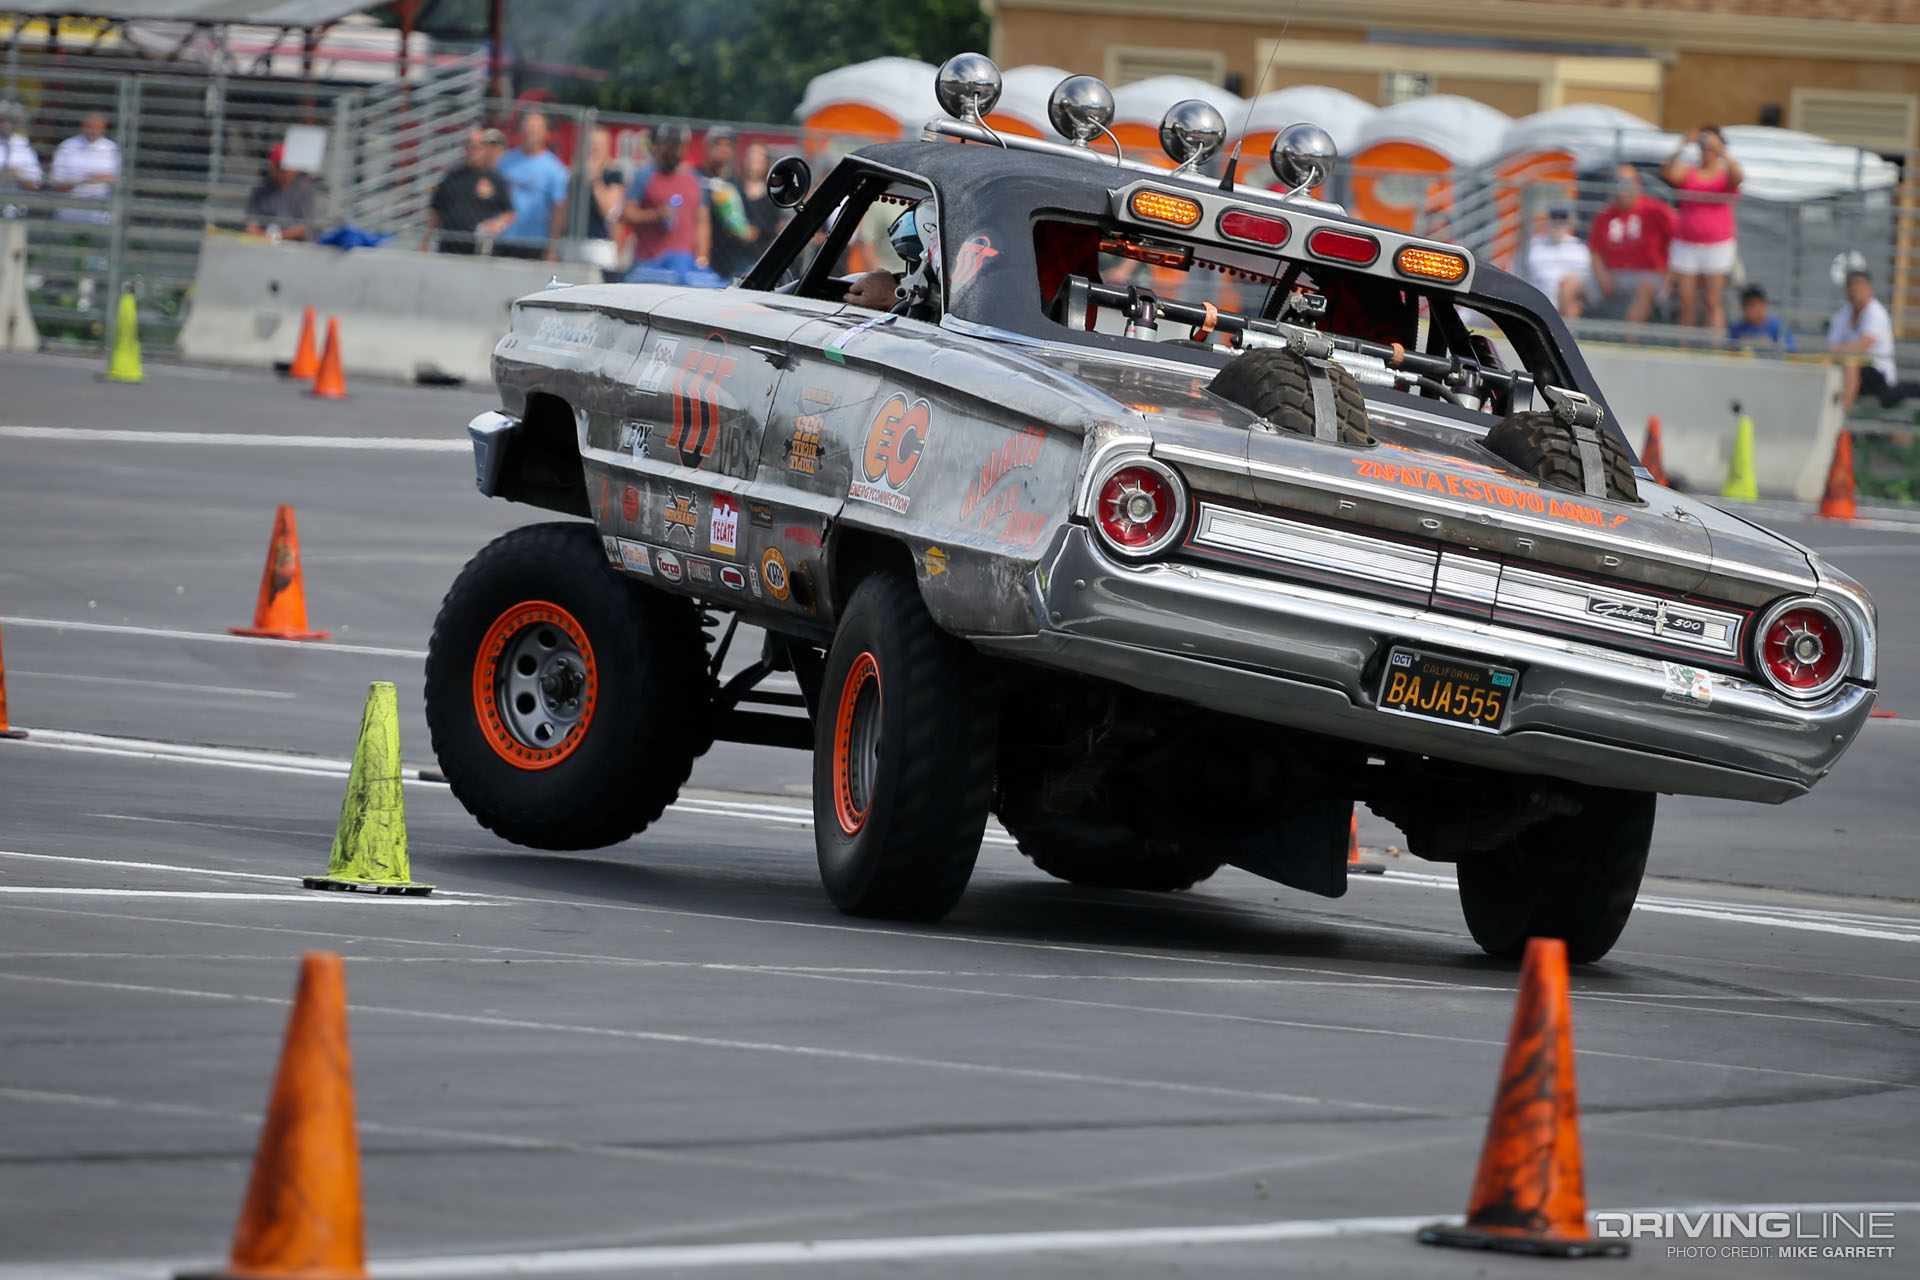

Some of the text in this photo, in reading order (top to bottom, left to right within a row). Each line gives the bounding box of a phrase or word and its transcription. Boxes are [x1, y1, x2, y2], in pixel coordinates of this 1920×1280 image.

[1352, 459, 1445, 493] ZAPATA
[1444, 475, 1544, 513] ESTUVO
[849, 483, 909, 511] ENERGYCONNECTION
[712, 520, 735, 543] TECATE
[657, 556, 680, 575] Torco
[1672, 617, 1701, 631] 500
[1393, 653, 1411, 665] OCT
[1423, 664, 1479, 681] CALIFORNIA
[1387, 672, 1502, 721] BAJA555
